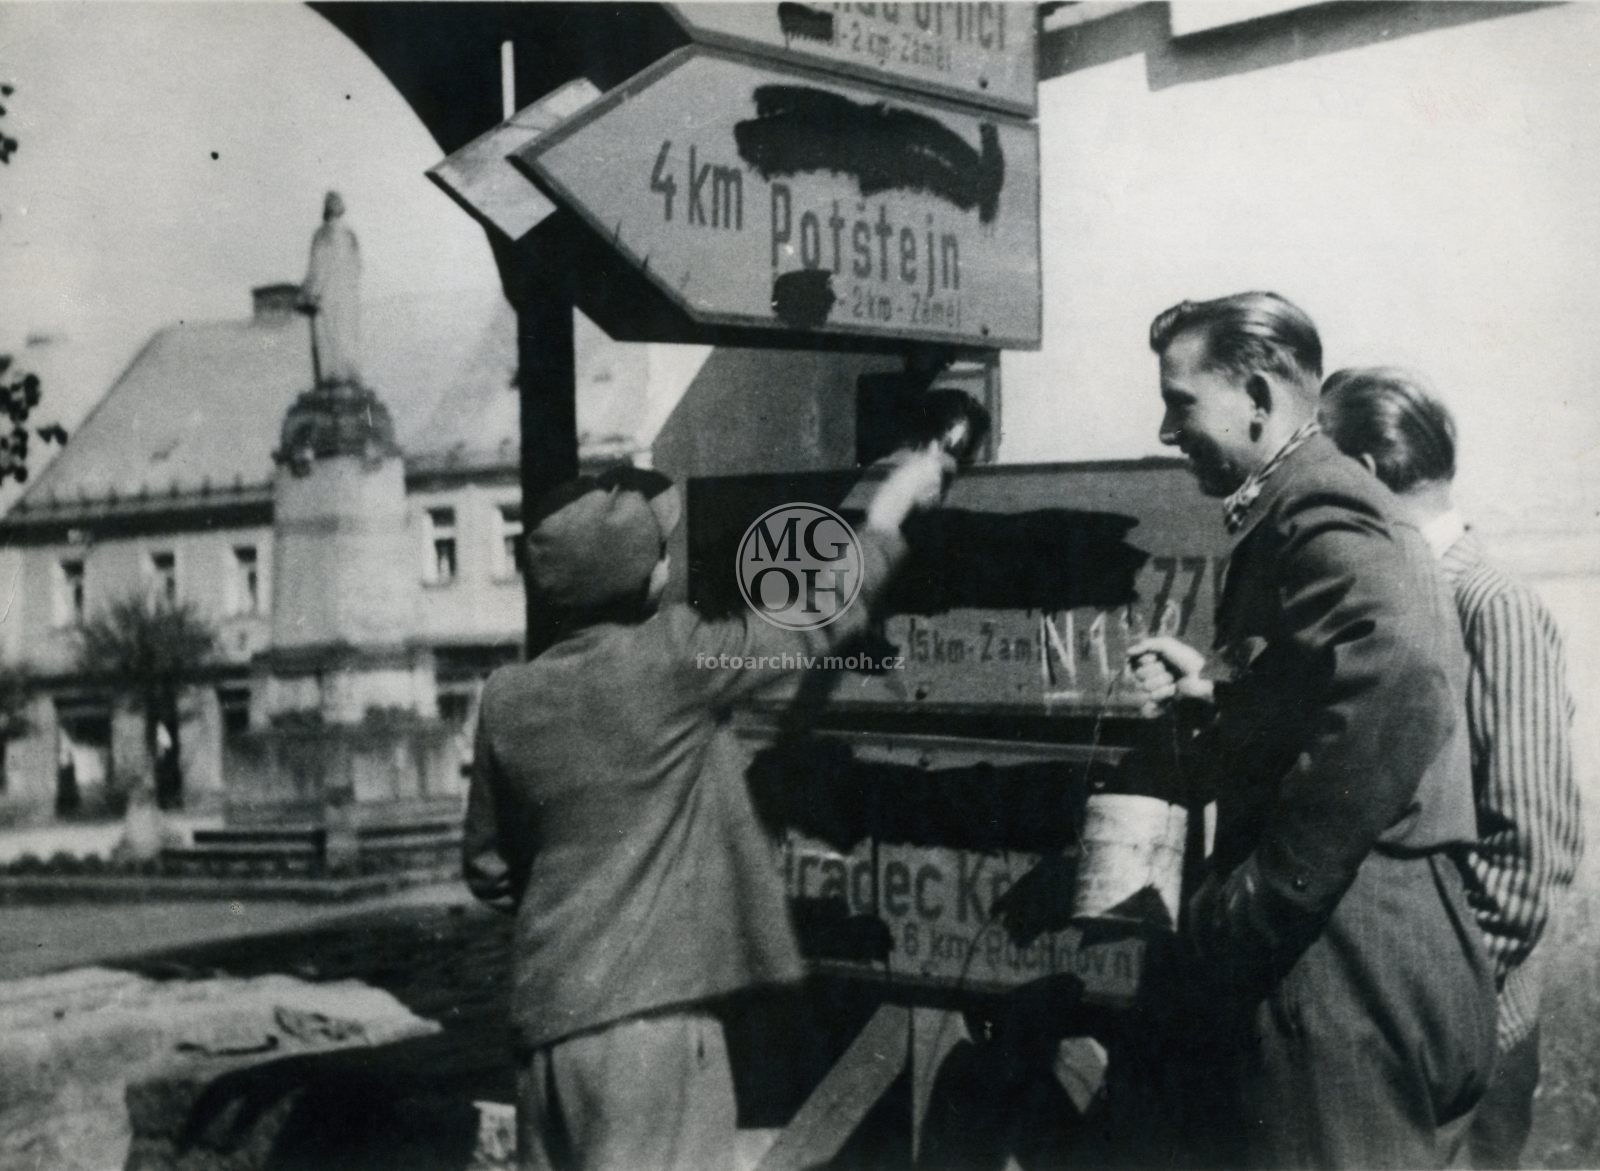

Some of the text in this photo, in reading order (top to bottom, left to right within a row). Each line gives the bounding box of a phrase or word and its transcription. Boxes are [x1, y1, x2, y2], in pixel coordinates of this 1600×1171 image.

[650, 139, 743, 230] 4 km
[770, 180, 961, 299] Potštejn
